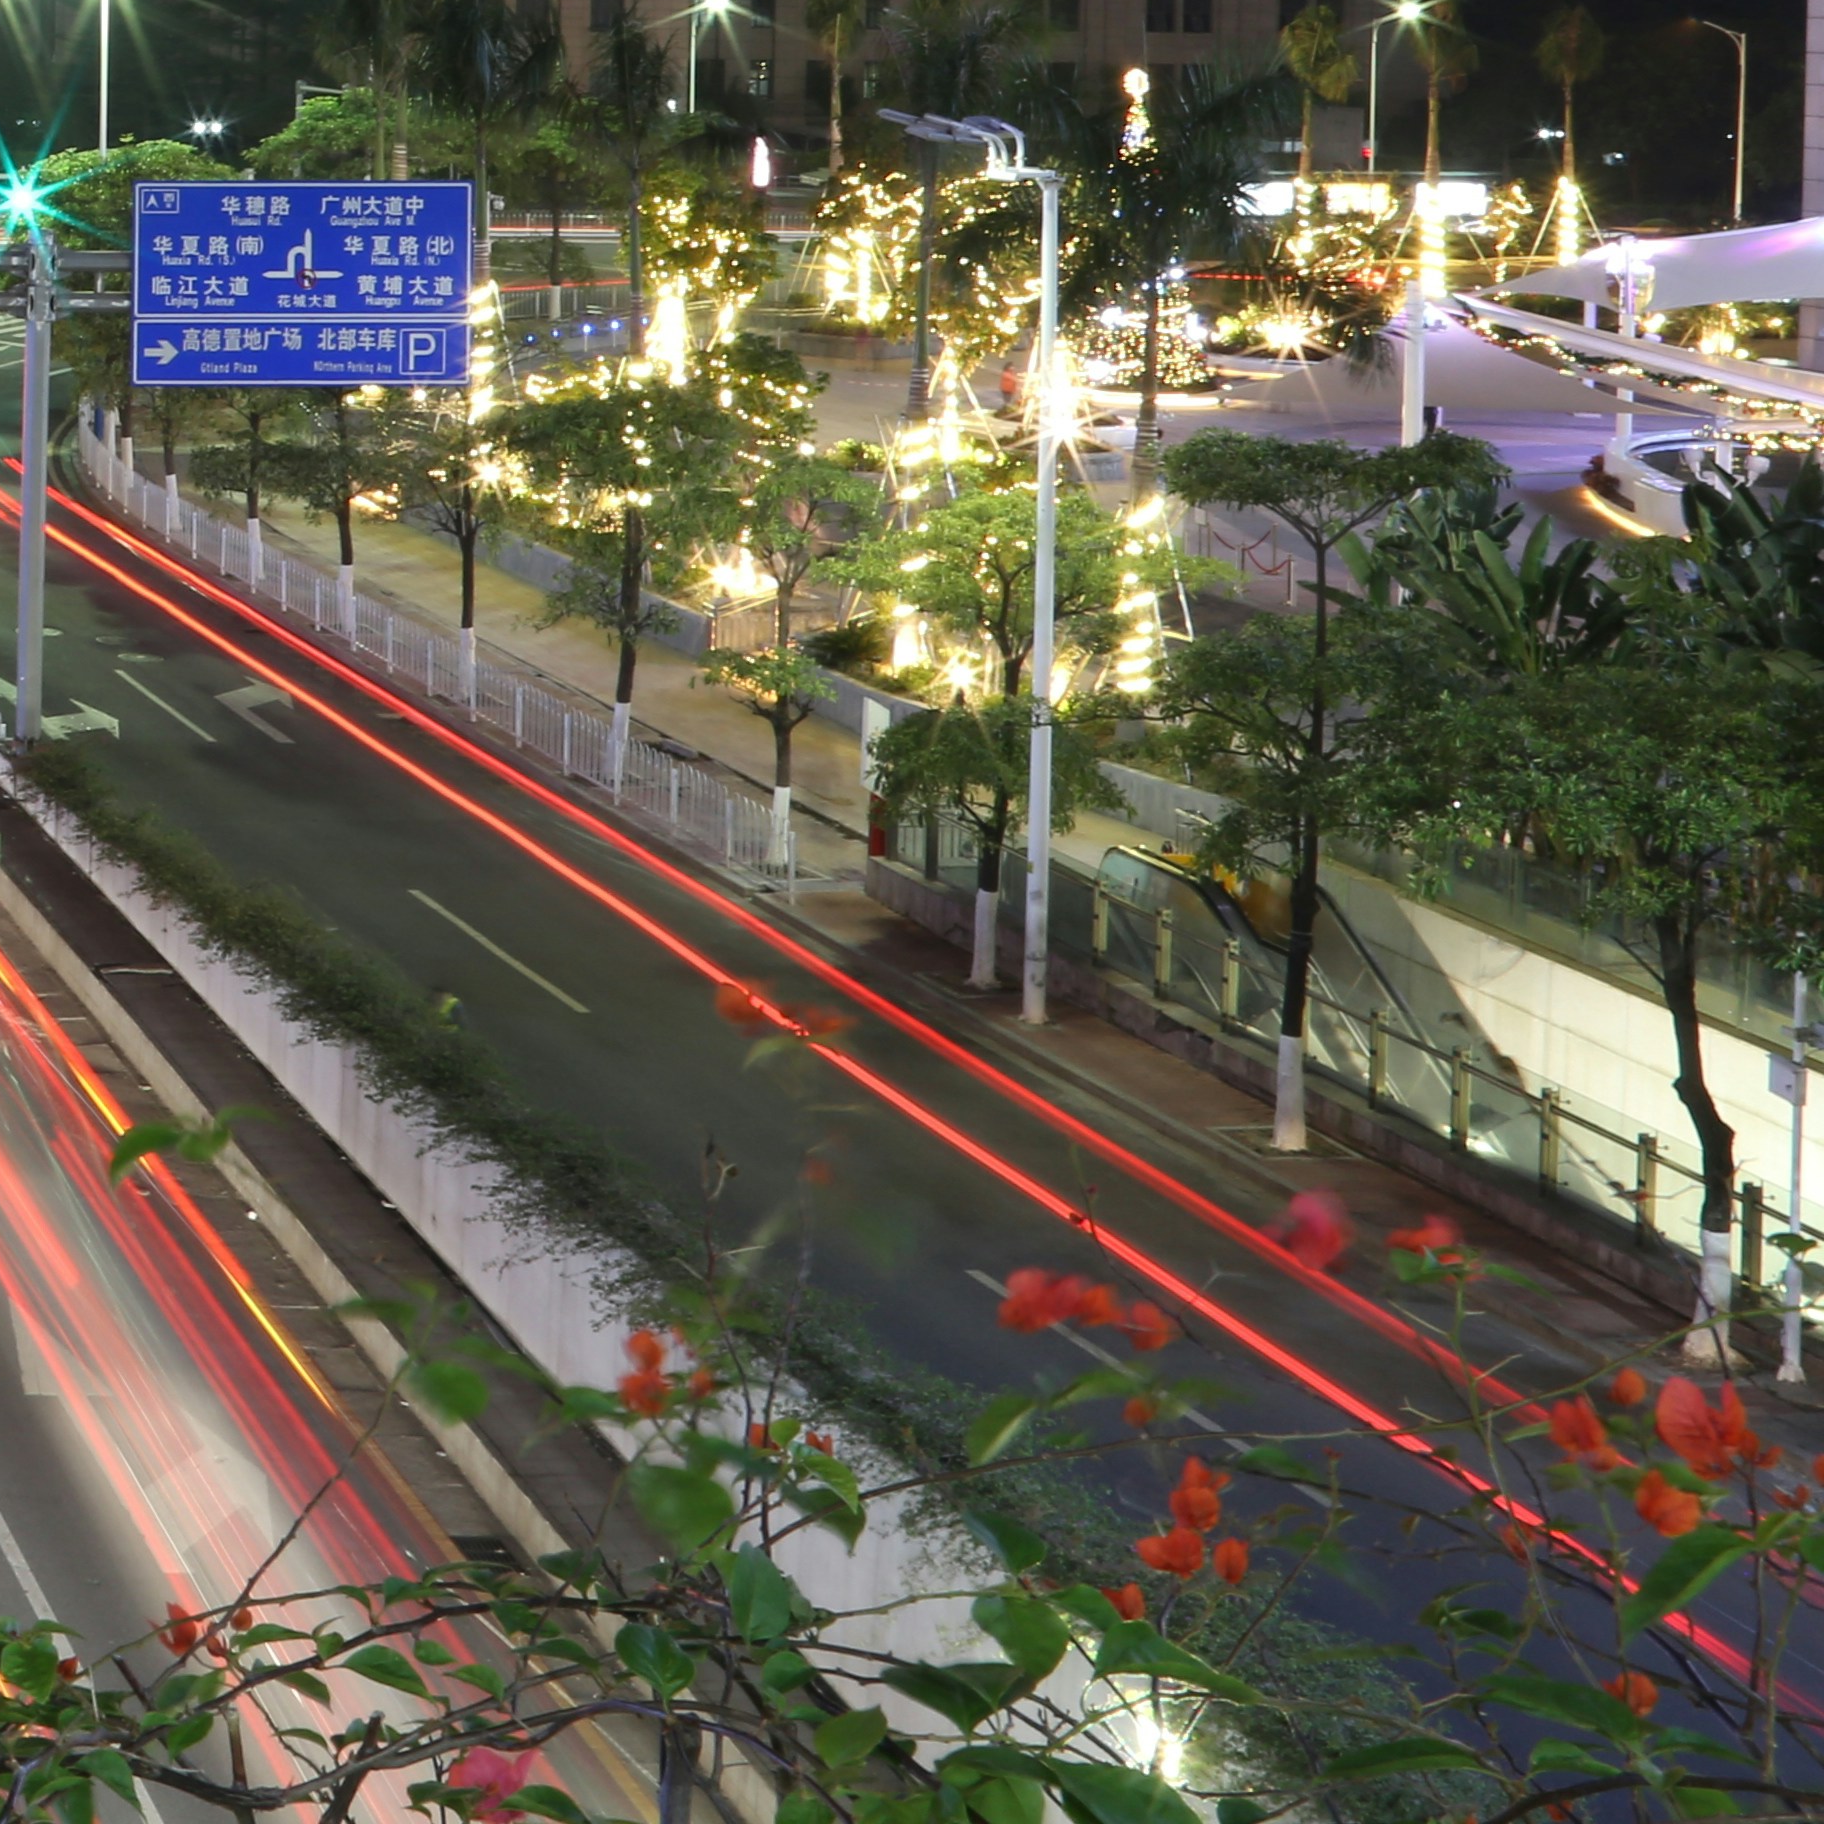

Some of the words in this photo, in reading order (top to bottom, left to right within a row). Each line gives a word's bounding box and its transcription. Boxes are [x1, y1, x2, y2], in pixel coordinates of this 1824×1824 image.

[221, 196, 290, 215] 华穗路
[320, 195, 424, 215] 广州大道中
[231, 216, 261, 226] Huasui
[267, 216, 282, 226] Rd.
[330, 215, 379, 228] Guangzhou
[384, 216, 401, 226] Ave
[162, 255, 191, 265] Huaxia
[198, 255, 213, 265] Rd.
[371, 255, 399, 266] Huaxia
[404, 256, 420, 266] Rd.
[152, 275, 249, 296] 临江大道
[357, 275, 453, 296] 黄埔大道
[165, 296, 198, 309] Linjiang
[204, 296, 235, 307] Avenue
[278, 294, 336, 308] 花城大道
[365, 296, 401, 308] Huangpu
[413, 296, 444, 306] Avenue
[182, 327, 302, 351] 高德置地广场
[317, 327, 397, 352] 北部车库
[409, 333, 436, 371] P
[233, 362, 258, 373] Plaza
